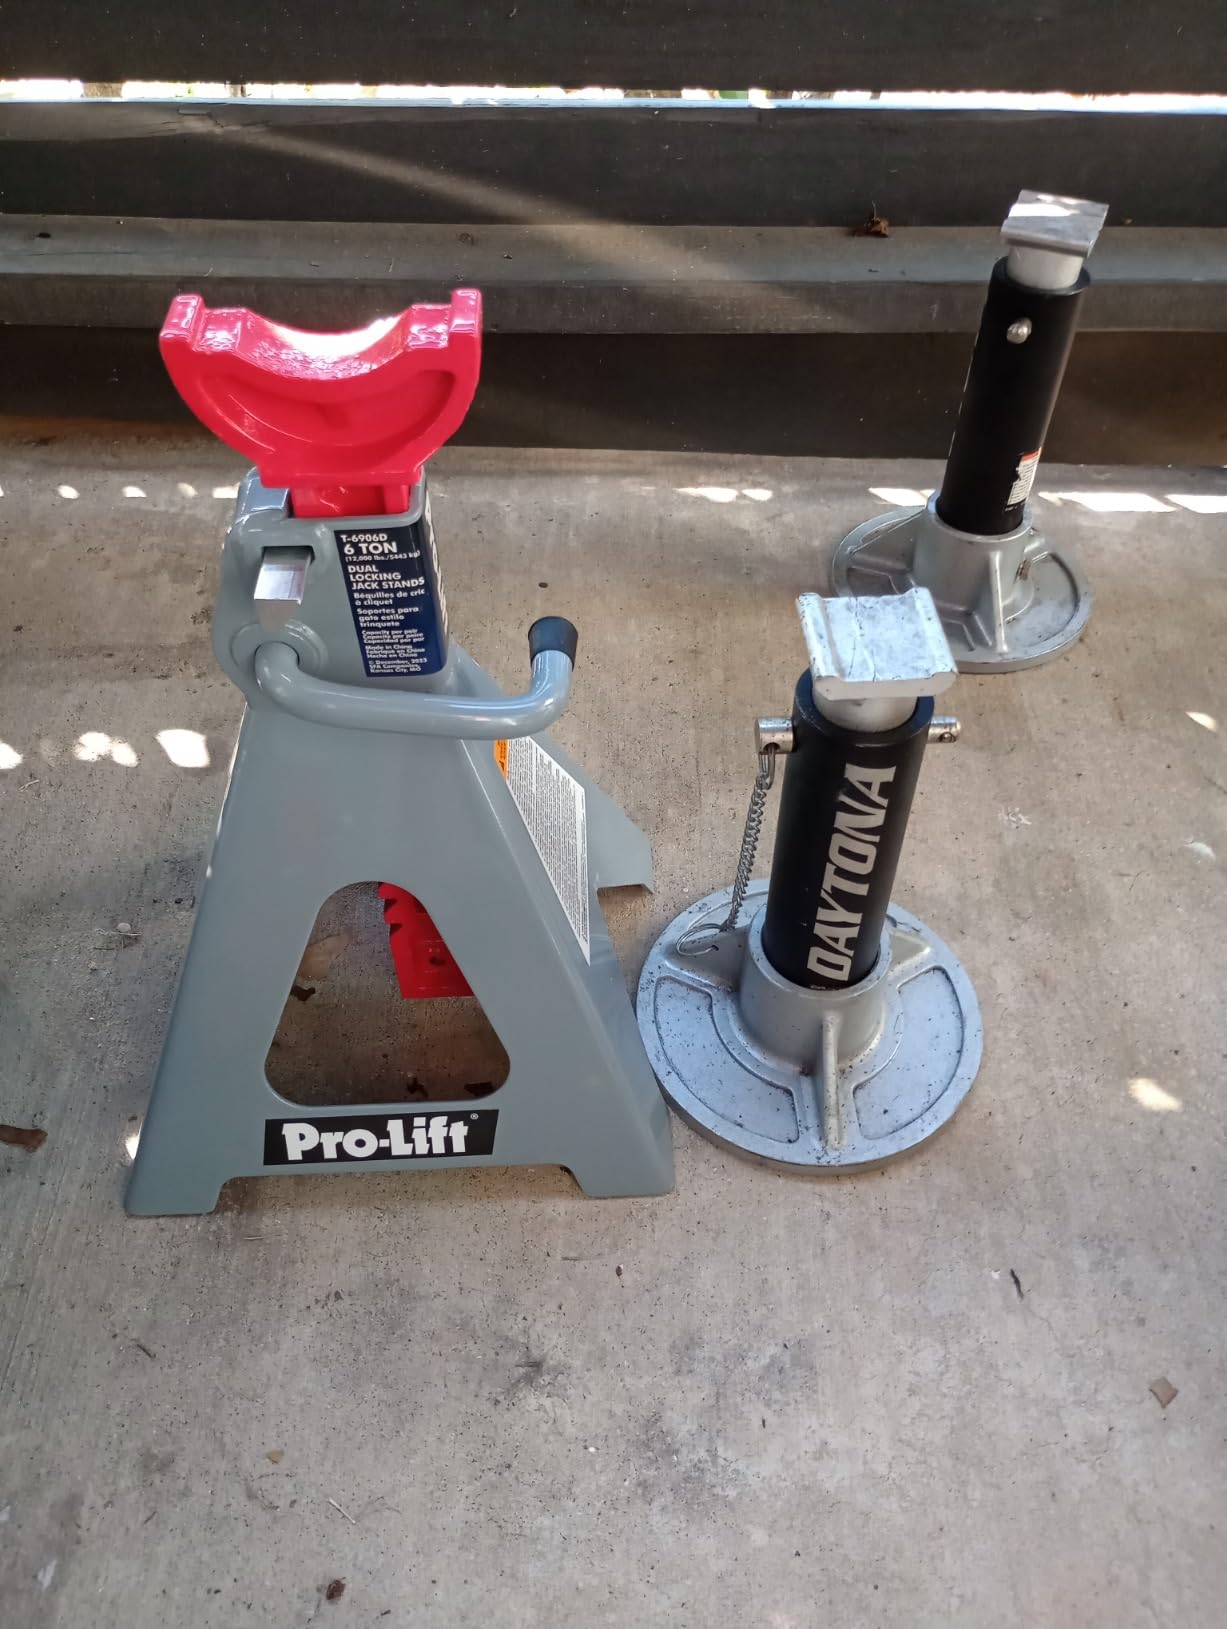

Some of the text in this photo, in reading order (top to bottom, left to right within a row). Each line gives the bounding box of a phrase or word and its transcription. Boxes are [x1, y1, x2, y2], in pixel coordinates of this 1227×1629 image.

[340, 534, 387, 542] T-6906D
[344, 542, 397, 555] 6 TON
[409, 550, 420, 558] kg)
[348, 565, 378, 573] DUAL
[350, 572, 401, 581] LOCKING
[352, 576, 425, 590] JACK STANDS
[410, 589, 425, 597] cric
[807, 763, 896, 981] DAYTONA
